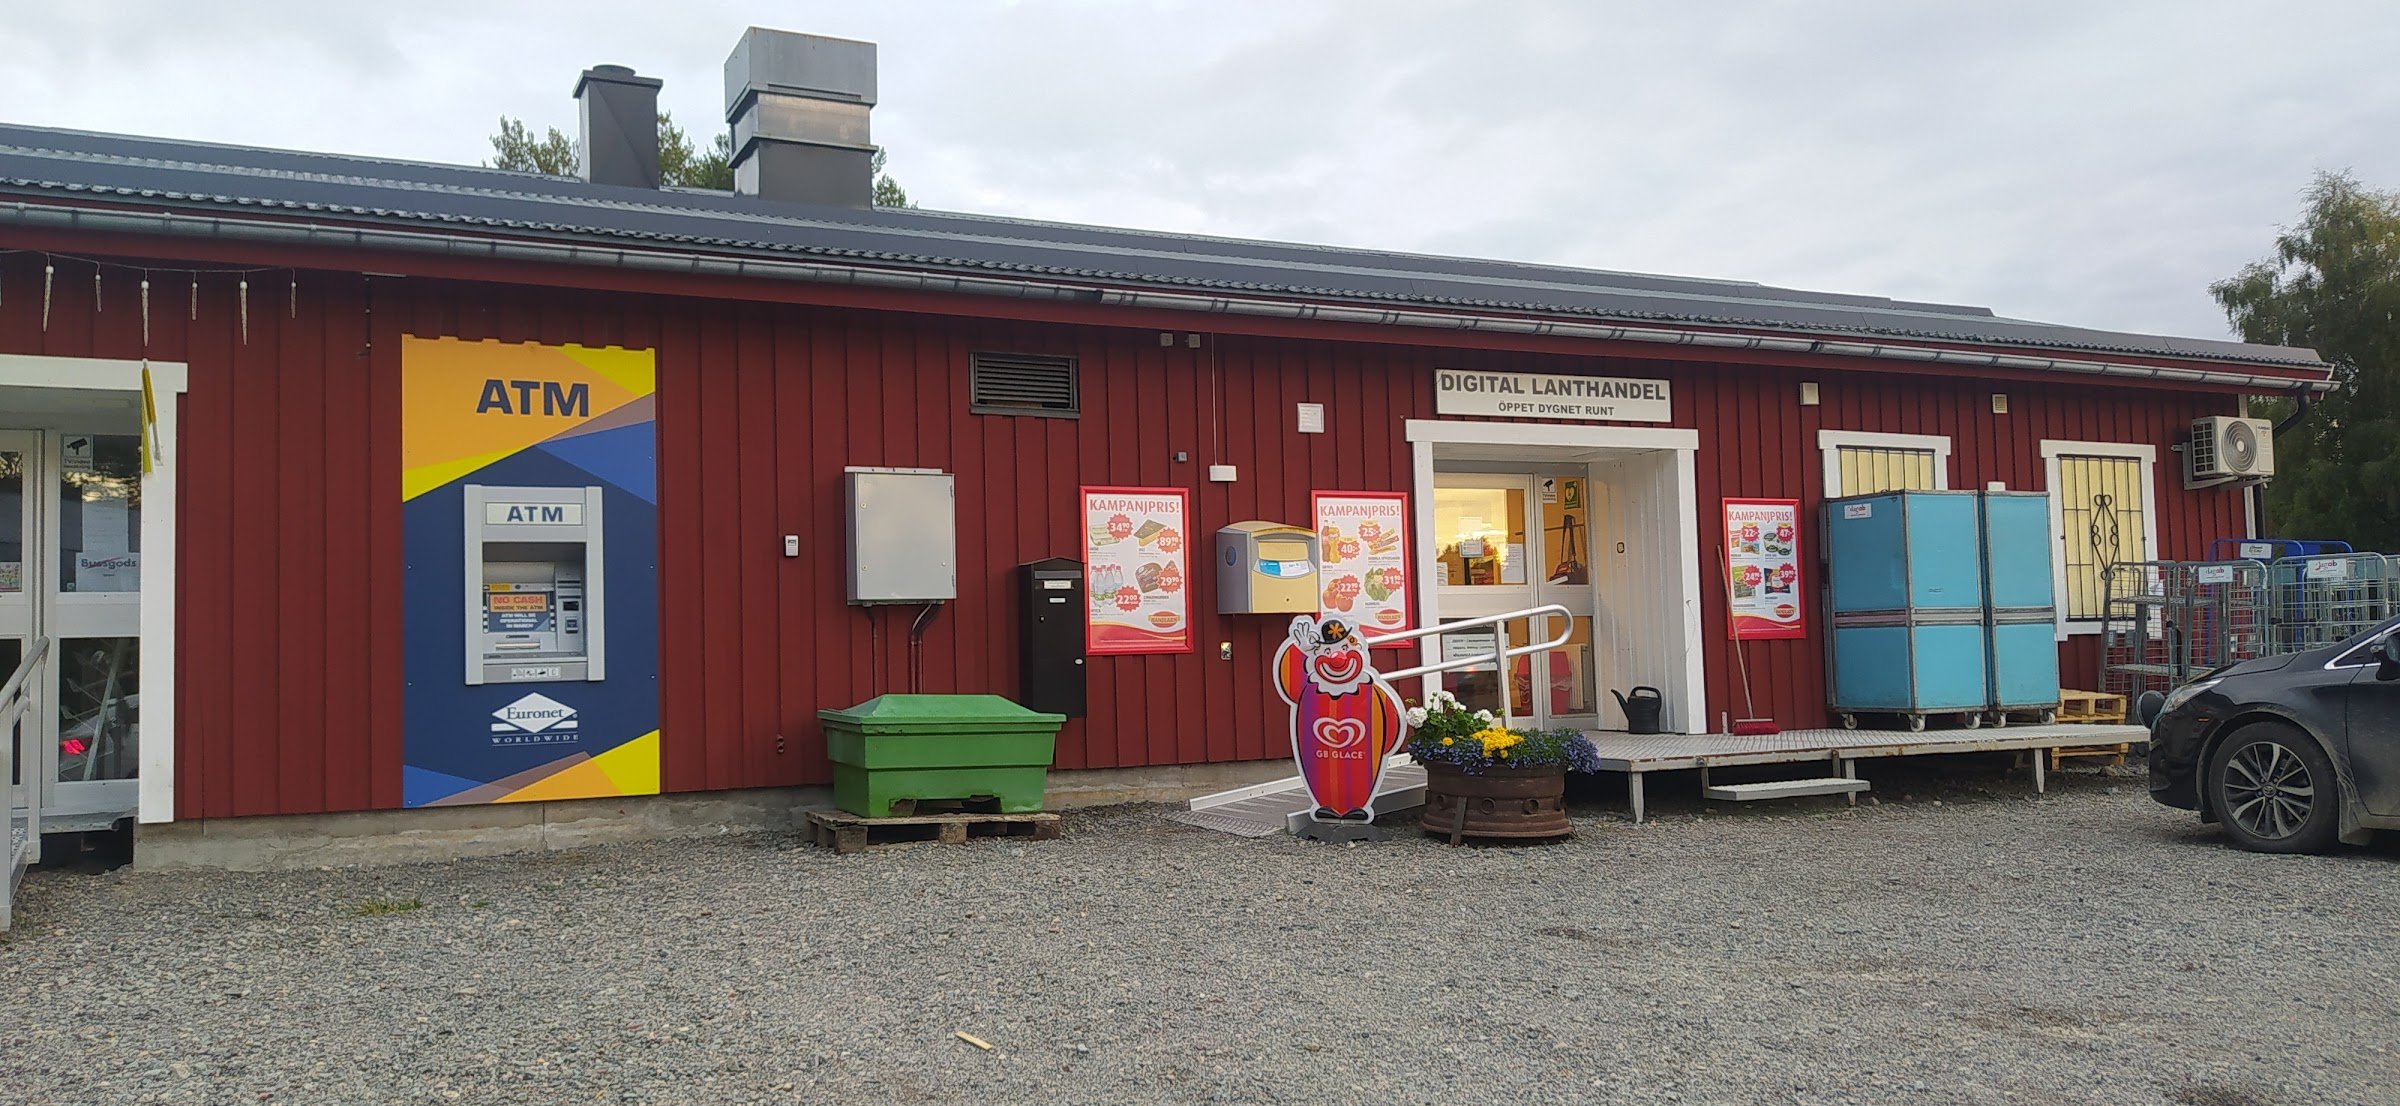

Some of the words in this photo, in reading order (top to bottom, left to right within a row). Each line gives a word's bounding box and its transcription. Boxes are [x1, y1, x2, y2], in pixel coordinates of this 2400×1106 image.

[1441, 374, 1525, 395] DIGITAL
[1532, 378, 1666, 401] LANTHANDEL
[476, 379, 590, 417] ATM
[1498, 401, 1535, 413] ÖPPET
[1538, 404, 1581, 415] DYGNET
[1585, 405, 1615, 416] RUNT
[506, 505, 564, 523] ATM
[1089, 499, 1180, 516] KAMPANJPRIS!
[1320, 505, 1400, 519] KAMPANJPRIS!
[1728, 510, 1793, 524] KAMPANJPRIS!
[506, 706, 564, 720] Euronet
[491, 734, 579, 744] WORLDWIDE
[1316, 750, 1329, 758] GB
[1331, 751, 1364, 760] GLACE
